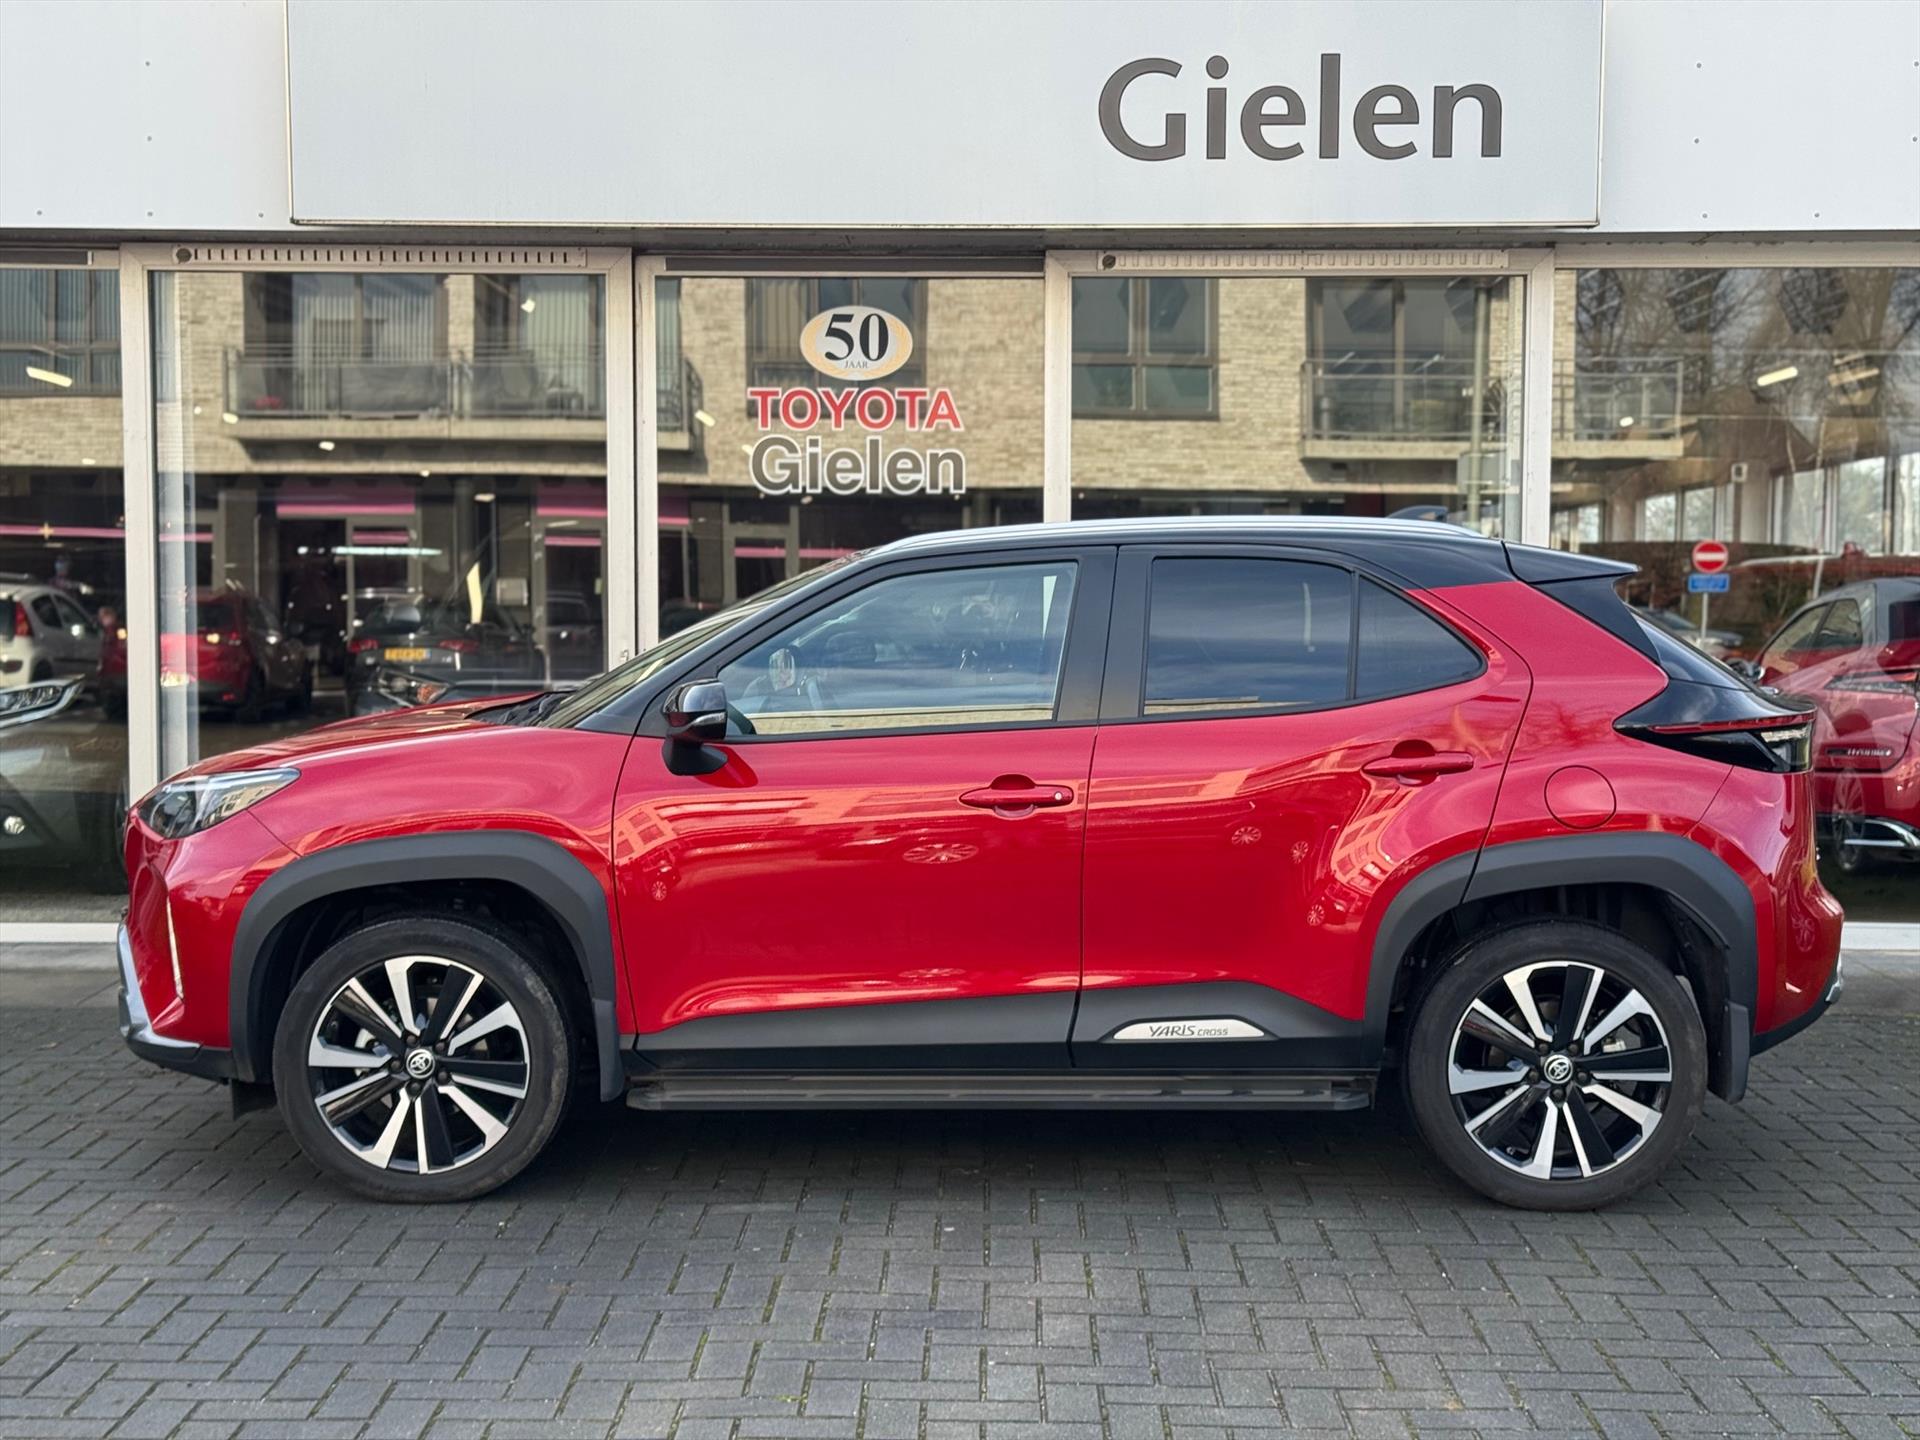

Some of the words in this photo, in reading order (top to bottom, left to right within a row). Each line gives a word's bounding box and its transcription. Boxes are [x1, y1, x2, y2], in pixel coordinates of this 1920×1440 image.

[1099, 53, 1502, 162] Gielen
[825, 313, 889, 362] 50
[844, 361, 869, 369] JAAR
[748, 387, 964, 431] TOYOTA
[750, 435, 966, 494] Gielen
[1149, 1024, 1196, 1037] YARIS
[1197, 1028, 1228, 1036] CROSS
